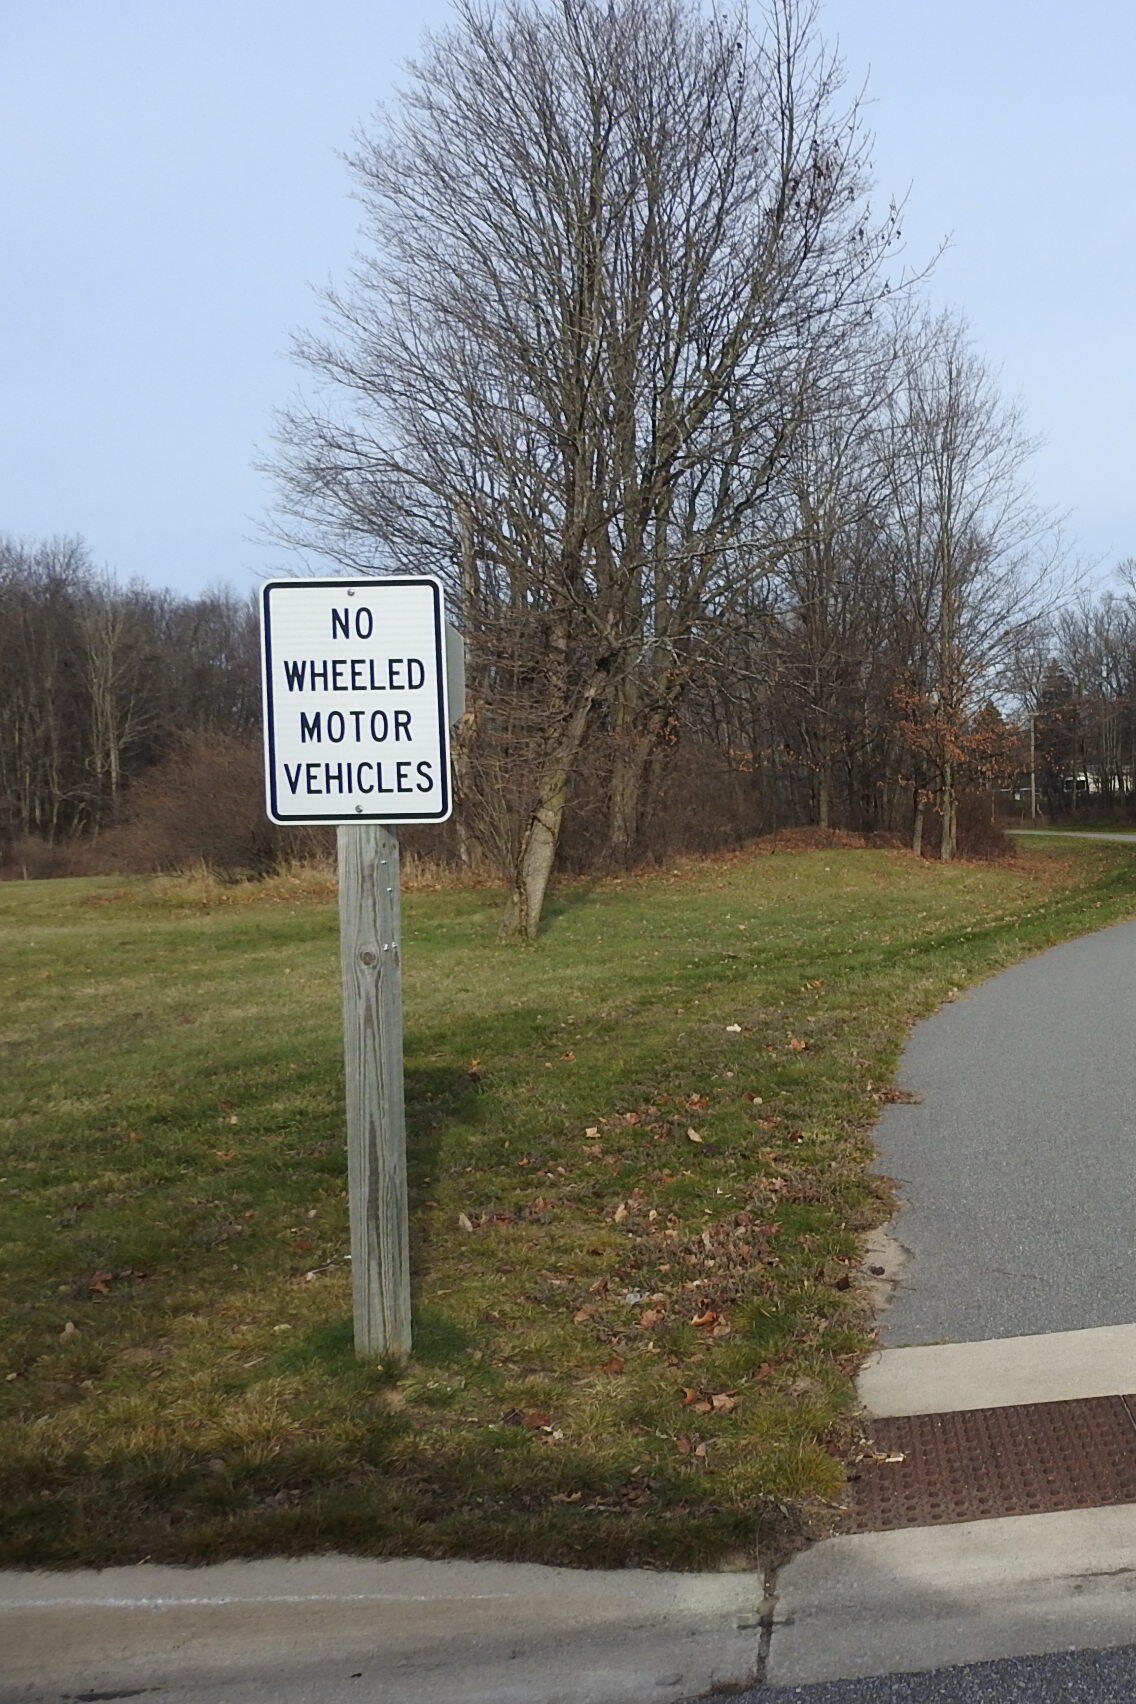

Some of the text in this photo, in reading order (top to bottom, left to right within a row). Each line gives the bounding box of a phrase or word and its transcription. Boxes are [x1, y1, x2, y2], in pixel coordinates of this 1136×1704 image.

[331, 607, 373, 639] NO
[284, 658, 425, 692] WHEELED
[300, 710, 413, 743] MOTOR
[283, 761, 434, 795] VEHICLES
